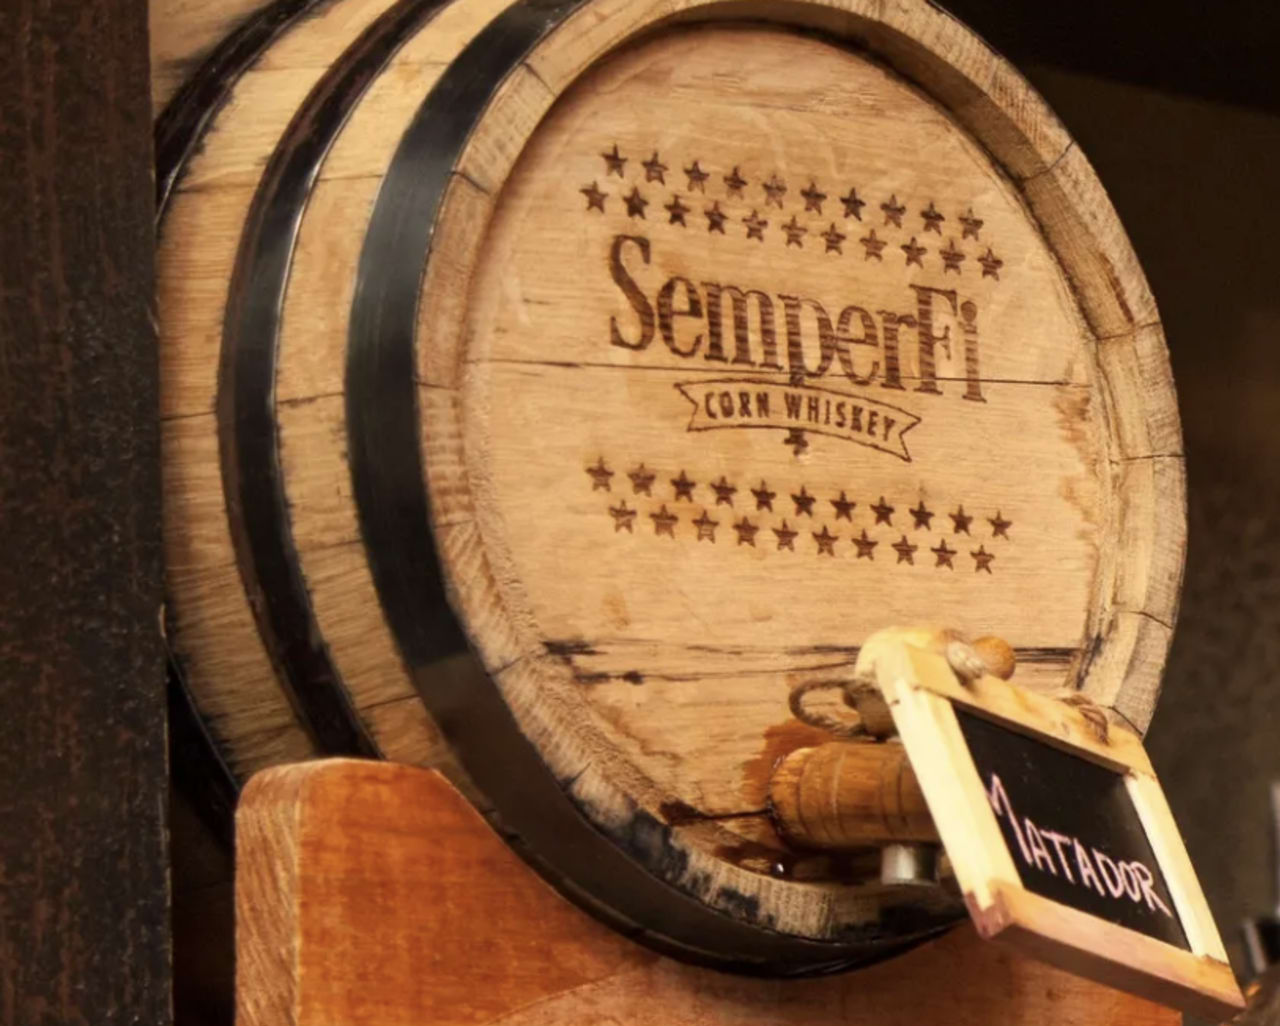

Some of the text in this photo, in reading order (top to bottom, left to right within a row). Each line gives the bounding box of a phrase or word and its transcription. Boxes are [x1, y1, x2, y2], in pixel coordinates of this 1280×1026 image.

[609, 233, 988, 404] SemperFi
[703, 387, 899, 444] CORN WHISKEY
[982, 772, 1172, 917] MATADOR
